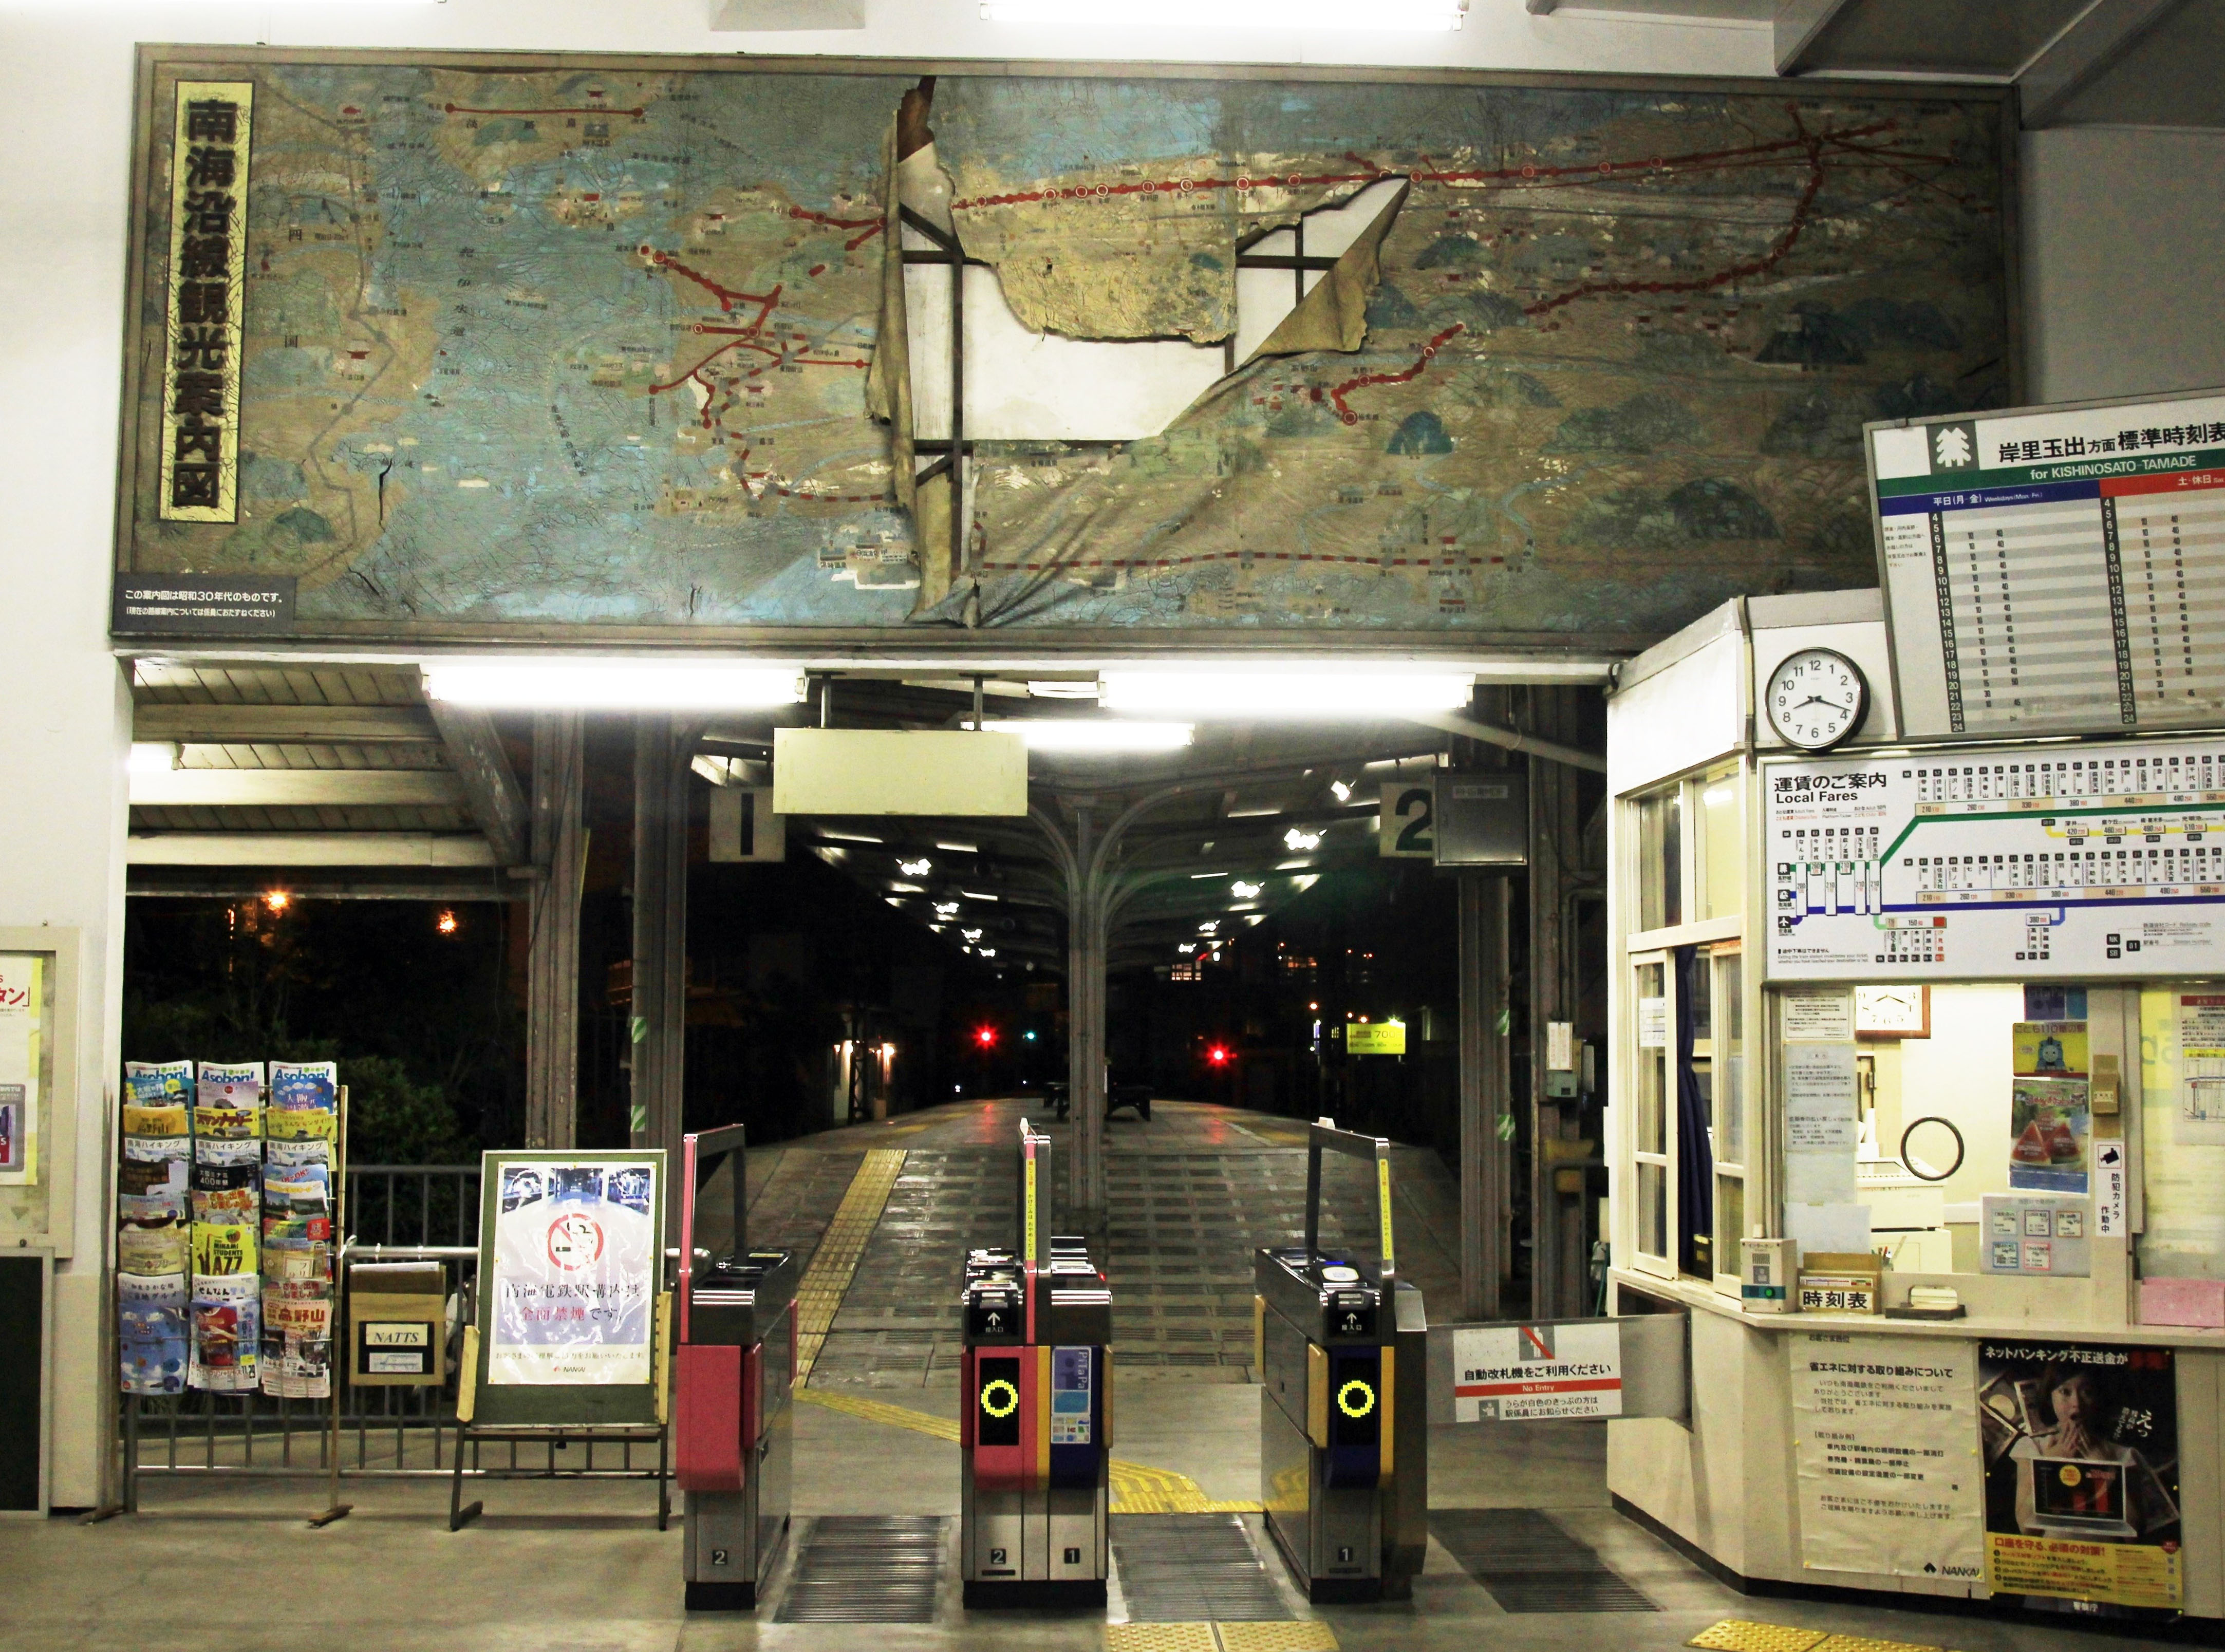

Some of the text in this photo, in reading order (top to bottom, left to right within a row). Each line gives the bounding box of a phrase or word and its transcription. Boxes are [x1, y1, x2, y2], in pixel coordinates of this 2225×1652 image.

[2030, 456, 2197, 480] for KISHINOSATO-TAMADE
[2106, 510, 2111, 518] 5
[2109, 565, 2119, 573] 10
[125, 590, 283, 603] この案内図は昭和30年代のものです。
[1794, 666, 1804, 677] 11
[1809, 660, 1821, 671] 12
[1829, 664, 1834, 674] 1
[1782, 680, 1794, 690] 10
[1840, 675, 1848, 686] 2
[1779, 696, 1786, 706] 9
[1845, 692, 1853, 703] 3
[1783, 712, 1791, 722] 8
[1840, 710, 1848, 720] 4
[1796, 725, 1803, 735] 7
[1811, 728, 1819, 738] 6
[1828, 723, 1836, 733] 5
[1774, 772, 1887, 792] 運賃のご案内
[1776, 792, 1858, 804] Local Fares
[1395, 788, 1433, 851] 2
[201, 1070, 254, 1083] Asobon!
[2111, 1173, 2120, 1219] 防犯カメラ
[2101, 1206, 2110, 1233] 作動中
[1803, 1290, 1867, 1309] 時刻表
[278, 1305, 325, 1322] 高野山
[373, 1331, 419, 1343] NATTS
[1985, 1346, 2128, 1365] ネットバンキング不正送金が
[1077, 1351, 1088, 1390] PiTaPa
[1464, 1363, 1612, 1381] 自動改札機をご利用ください
[1809, 1362, 1953, 1378] 省エネに対する取り組みについて
[1535, 1384, 1555, 1393] Entry
[1505, 1397, 1598, 1407] うらが白色のきっぷの方は
[1505, 1405, 1599, 1418] 駅係員にお知らせください
[715, 1551, 726, 1565] 2
[993, 1550, 1004, 1564] 2
[1068, 1550, 1077, 1563] 1
[1342, 1548, 1350, 1561] 1
[1941, 1565, 1980, 1578] NANKAI
